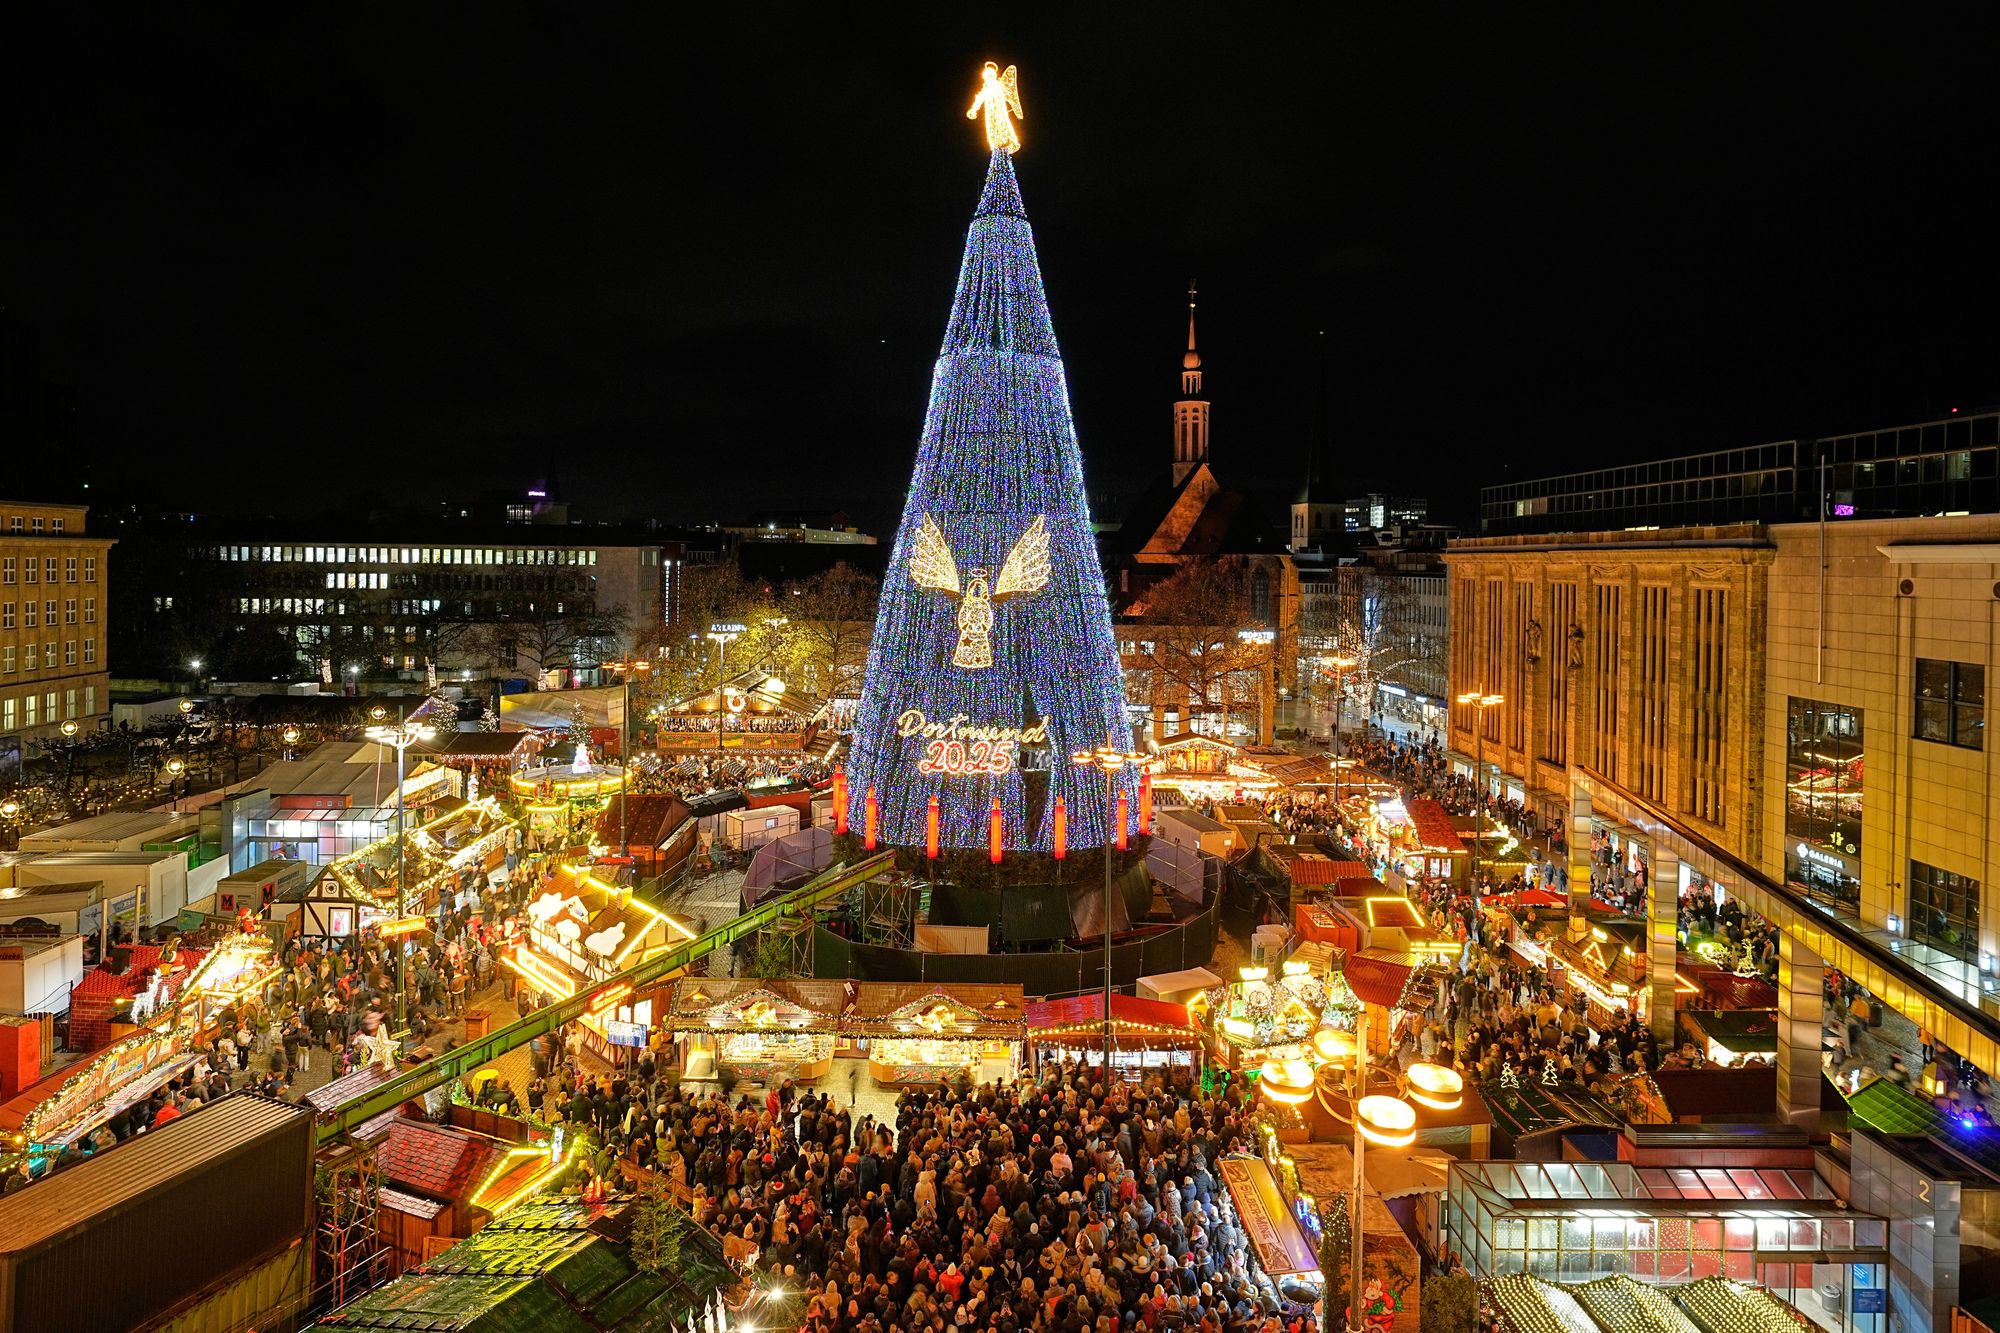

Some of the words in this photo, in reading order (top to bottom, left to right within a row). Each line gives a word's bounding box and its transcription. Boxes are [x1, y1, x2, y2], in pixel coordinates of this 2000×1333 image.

[898, 710, 1050, 743] Dortmund
[919, 740, 1014, 774] 2025
[1808, 850, 1843, 869] GALERIA
[1919, 1179, 1930, 1203] 2
